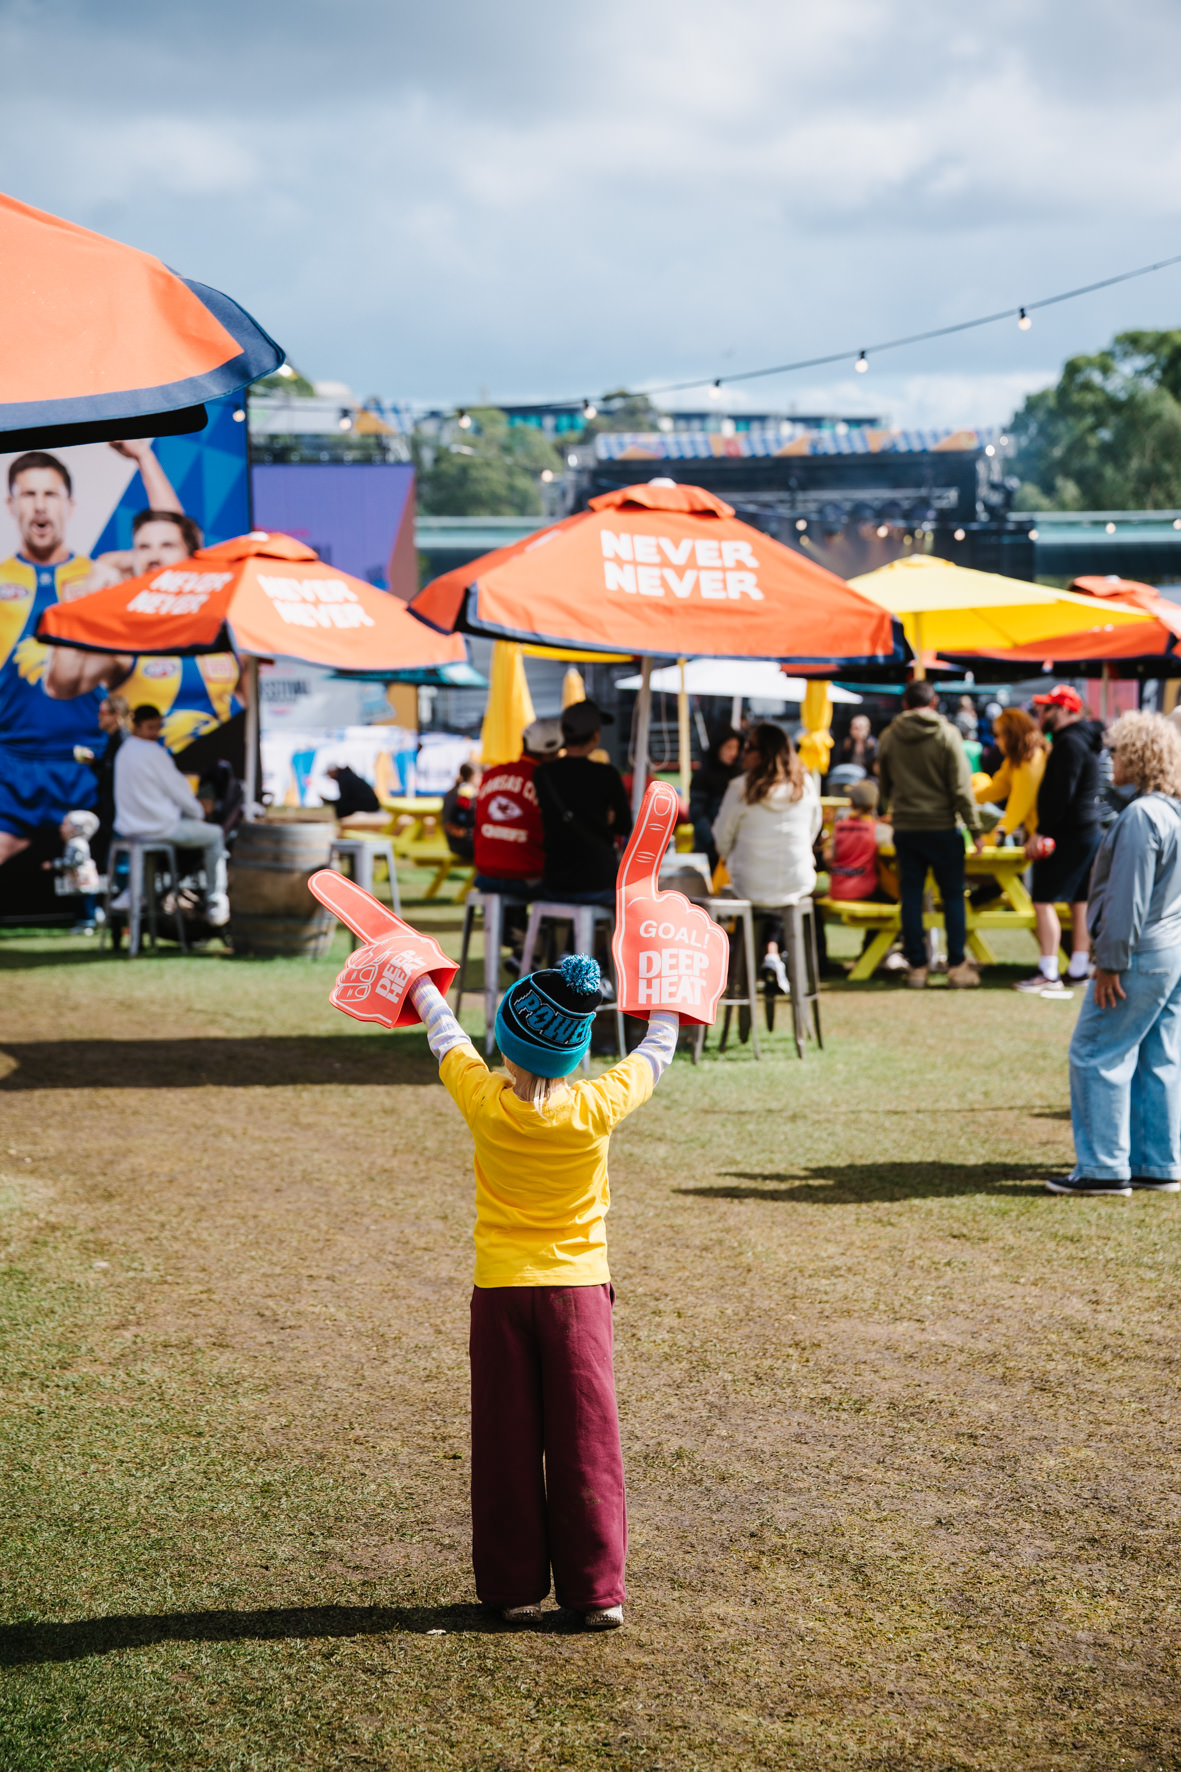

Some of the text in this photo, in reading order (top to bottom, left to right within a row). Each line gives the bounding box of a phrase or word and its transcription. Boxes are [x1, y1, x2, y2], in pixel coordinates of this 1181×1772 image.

[600, 529, 760, 568] NEVER
[256, 573, 359, 602] NEVER
[604, 560, 765, 600] NEVER
[272, 599, 376, 628] NEVER
[639, 920, 710, 949] GOAL!
[375, 949, 417, 998] DEEP
[638, 948, 710, 977] DEEP
[385, 956, 428, 1004] HEAT
[638, 975, 707, 1006] HEAT
